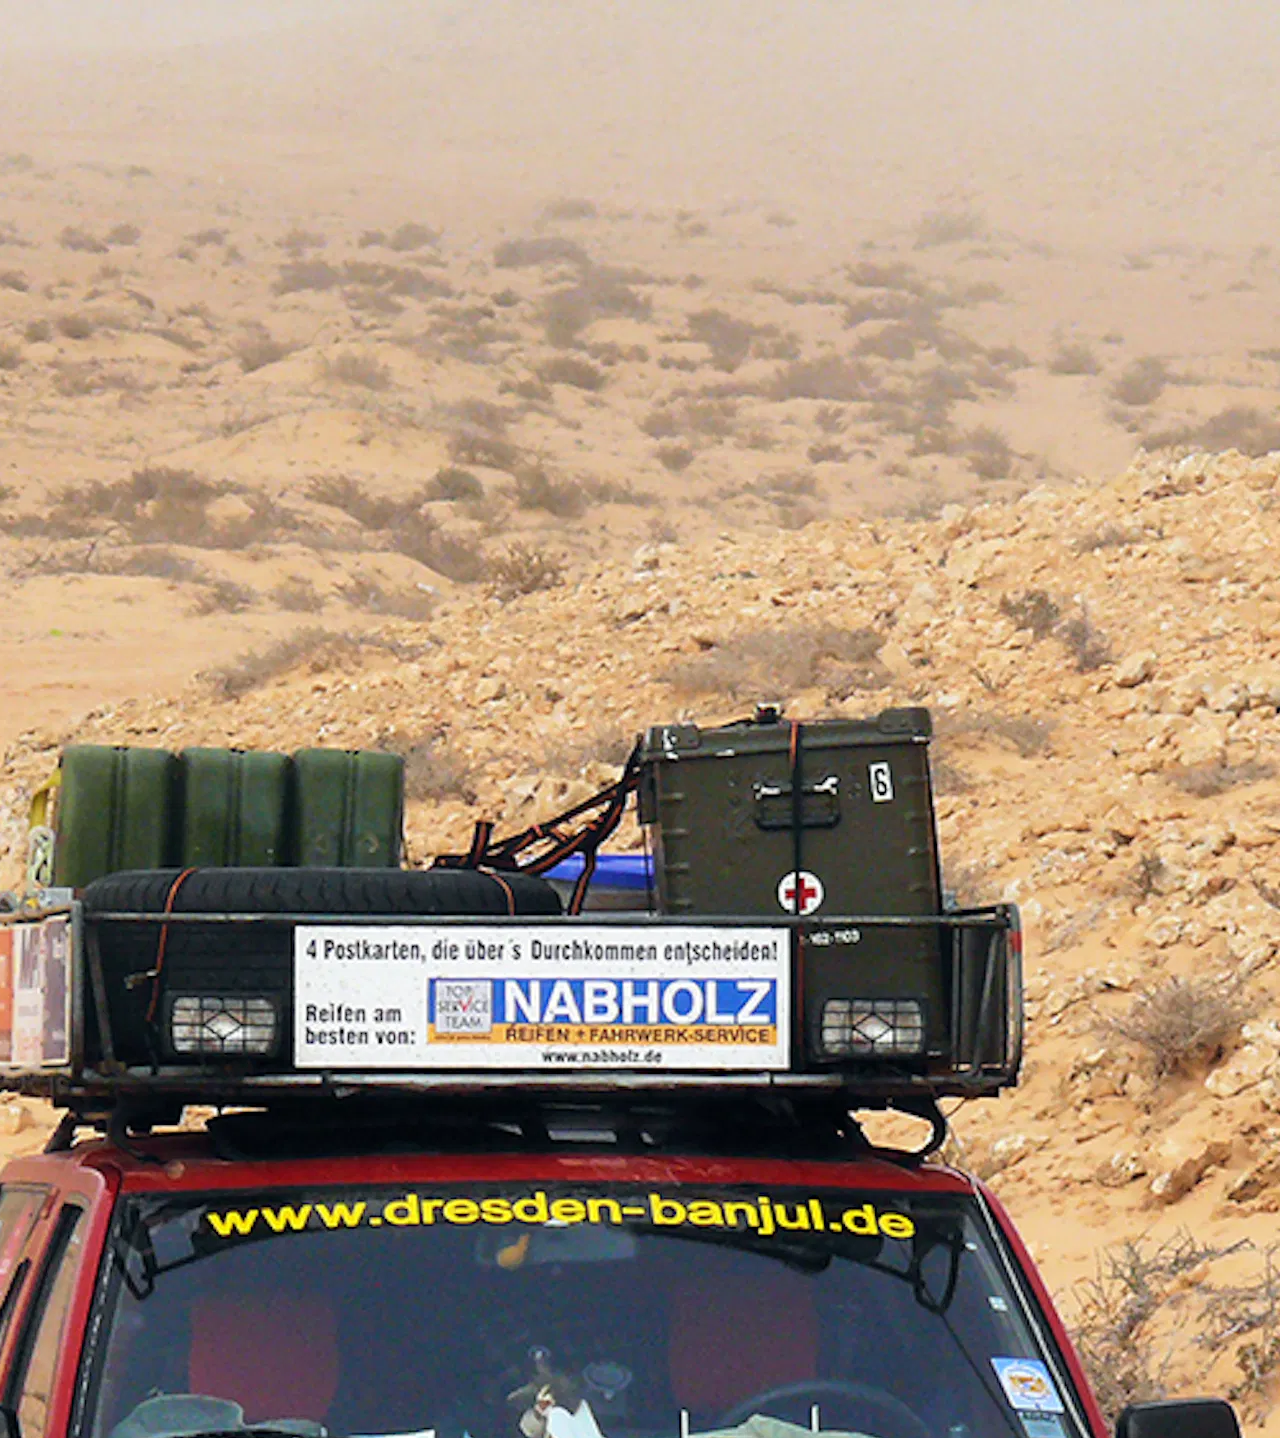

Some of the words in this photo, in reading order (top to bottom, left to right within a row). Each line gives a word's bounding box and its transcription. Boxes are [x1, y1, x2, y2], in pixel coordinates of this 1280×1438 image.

[305, 939, 318, 960] 4
[323, 939, 426, 963] Postkarten,
[431, 938, 460, 960] die
[531, 940, 657, 961] Durchkommen
[663, 940, 778, 964] entscheiden!
[504, 979, 771, 1024] NABHOLZ
[305, 1002, 366, 1022] Reifen
[373, 1007, 402, 1022] am
[445, 1015, 484, 1029] TEAM
[305, 1027, 368, 1045] besten
[375, 1029, 416, 1045] von:
[505, 1027, 569, 1042] REIFEN
[589, 1027, 770, 1043] FAHRWERK-SERVICE
[541, 1050, 663, 1064] www.nabholz.de
[208, 1191, 916, 1239] www.dresden-banjul.de
